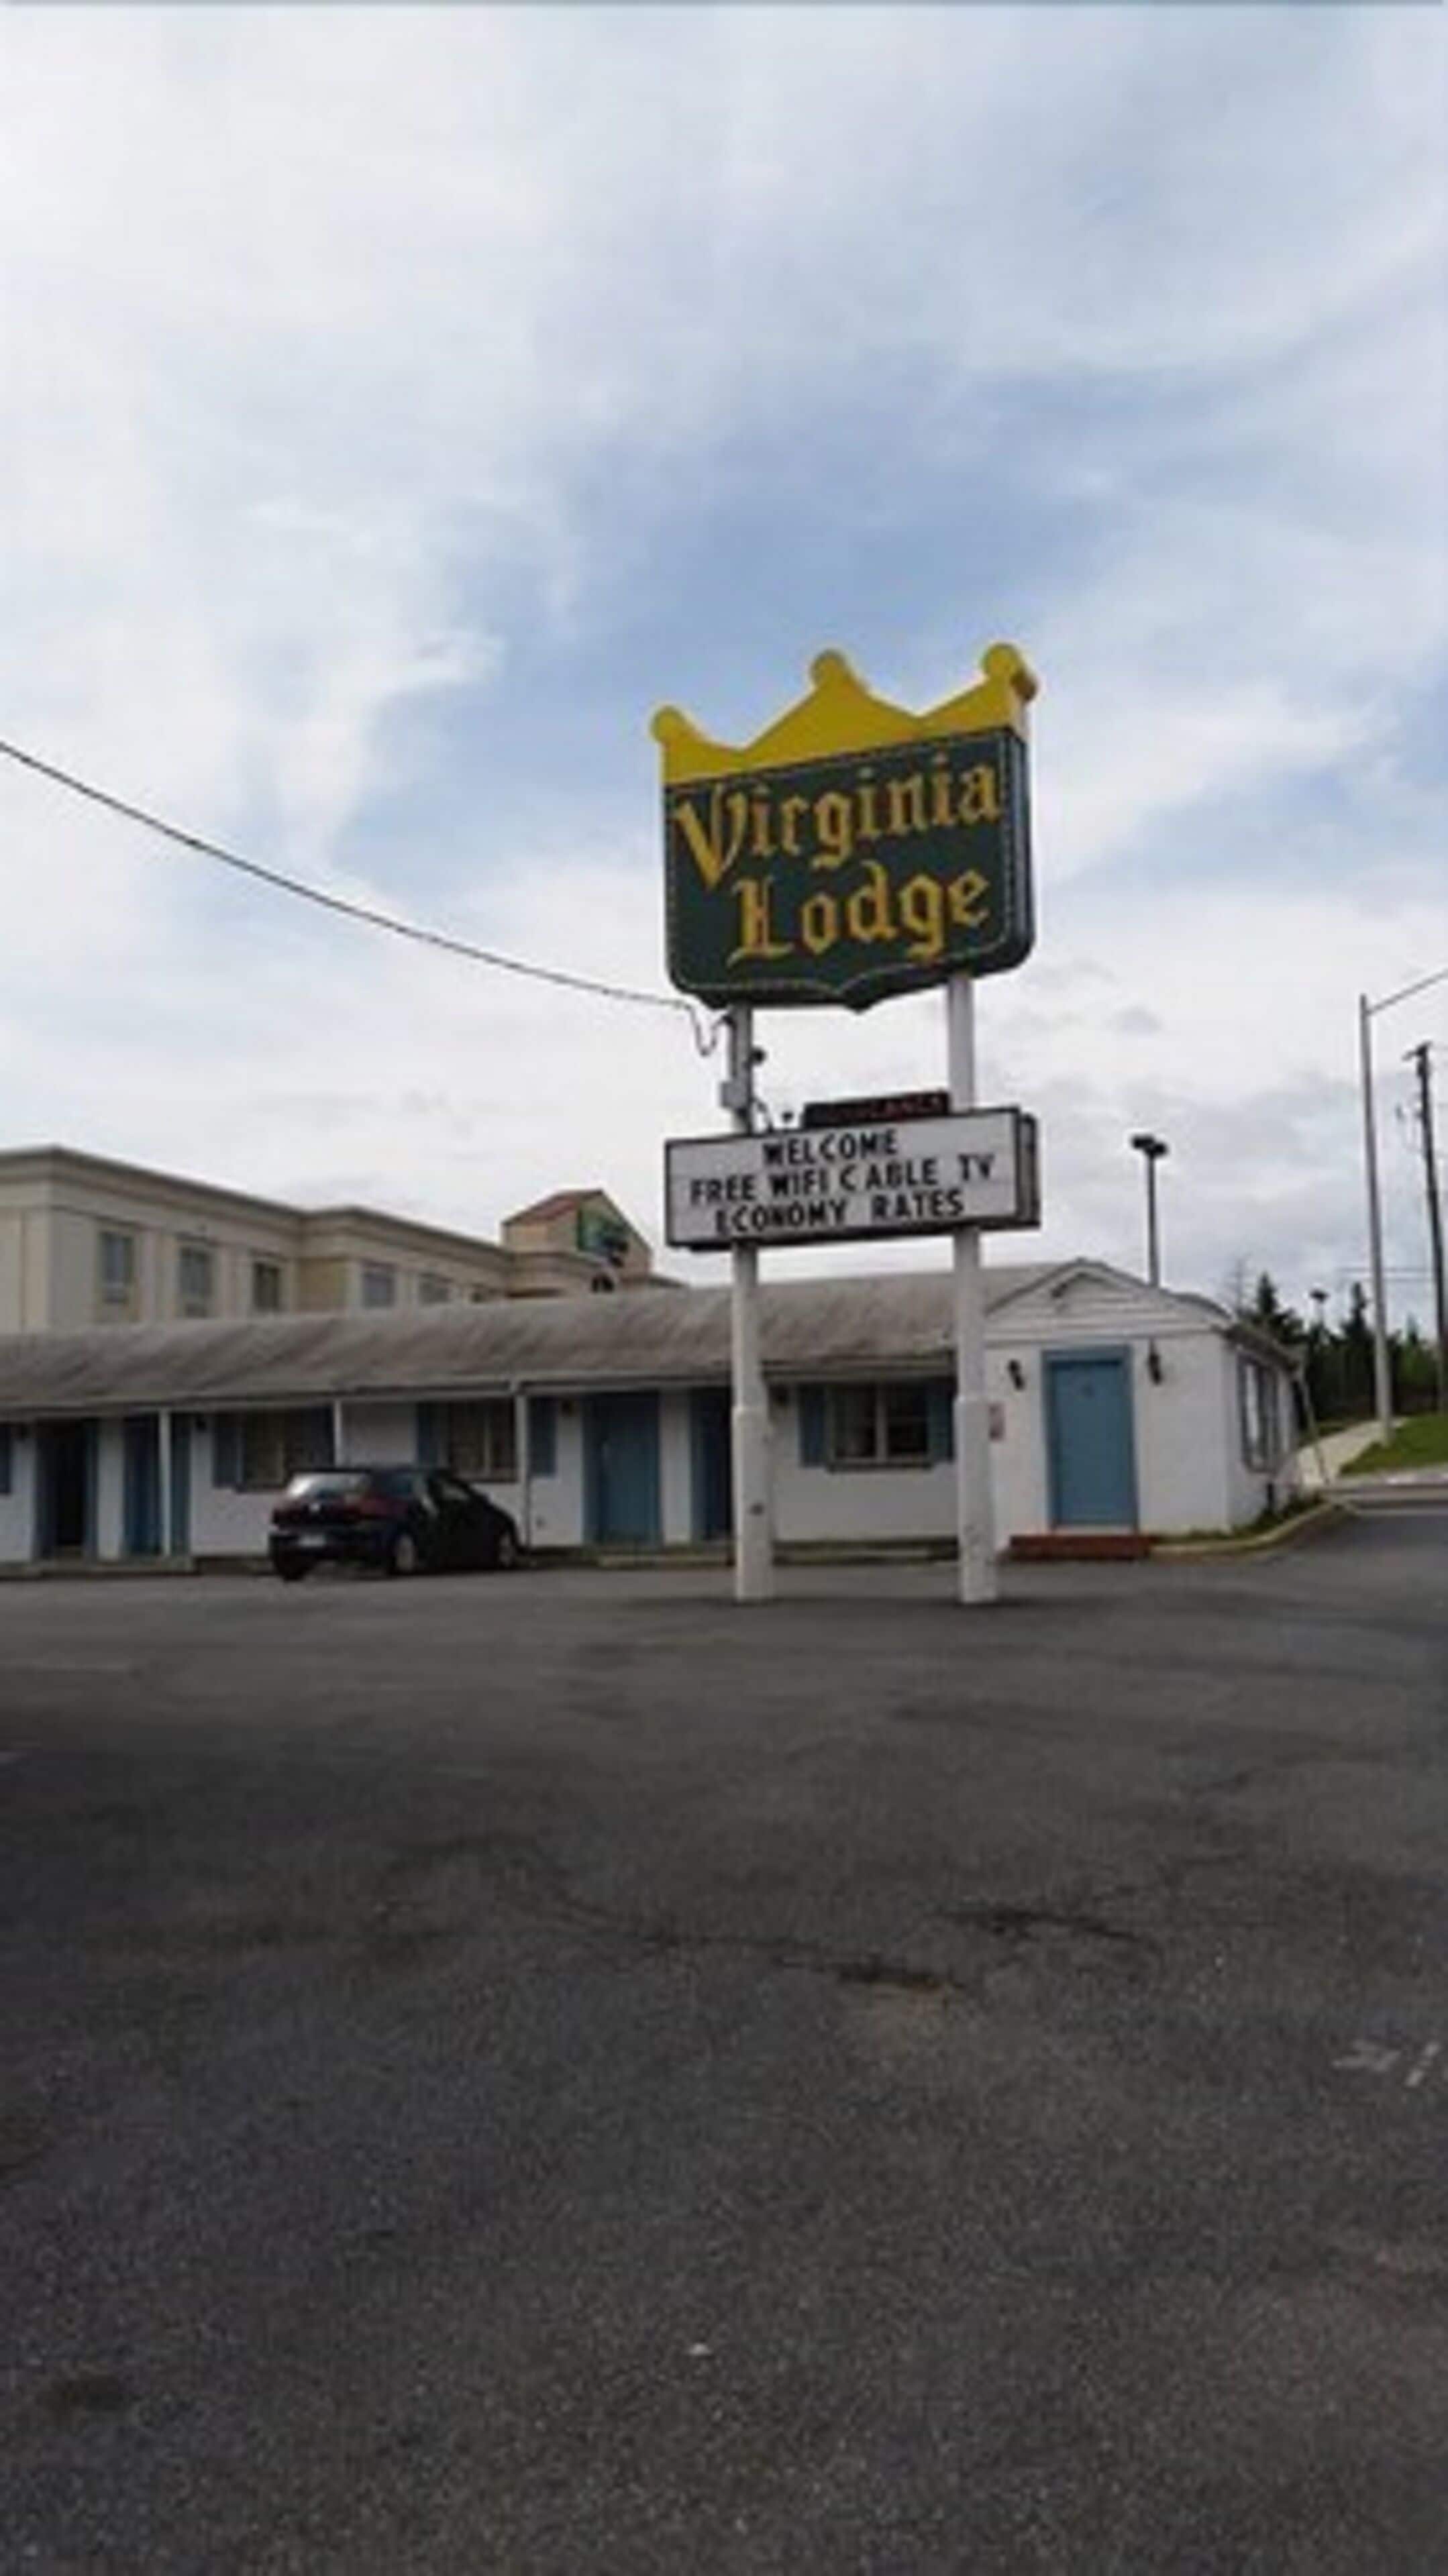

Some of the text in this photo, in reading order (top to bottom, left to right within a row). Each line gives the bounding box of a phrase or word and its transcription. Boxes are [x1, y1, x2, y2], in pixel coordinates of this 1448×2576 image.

[673, 752, 1000, 892] Virginia
[727, 860, 990, 968] Lodge
[763, 1130, 898, 1166] WELCOME
[690, 1154, 995, 1205] FREE WIFI CABLE TV
[717, 1190, 965, 1234] ECONOMY RATES
